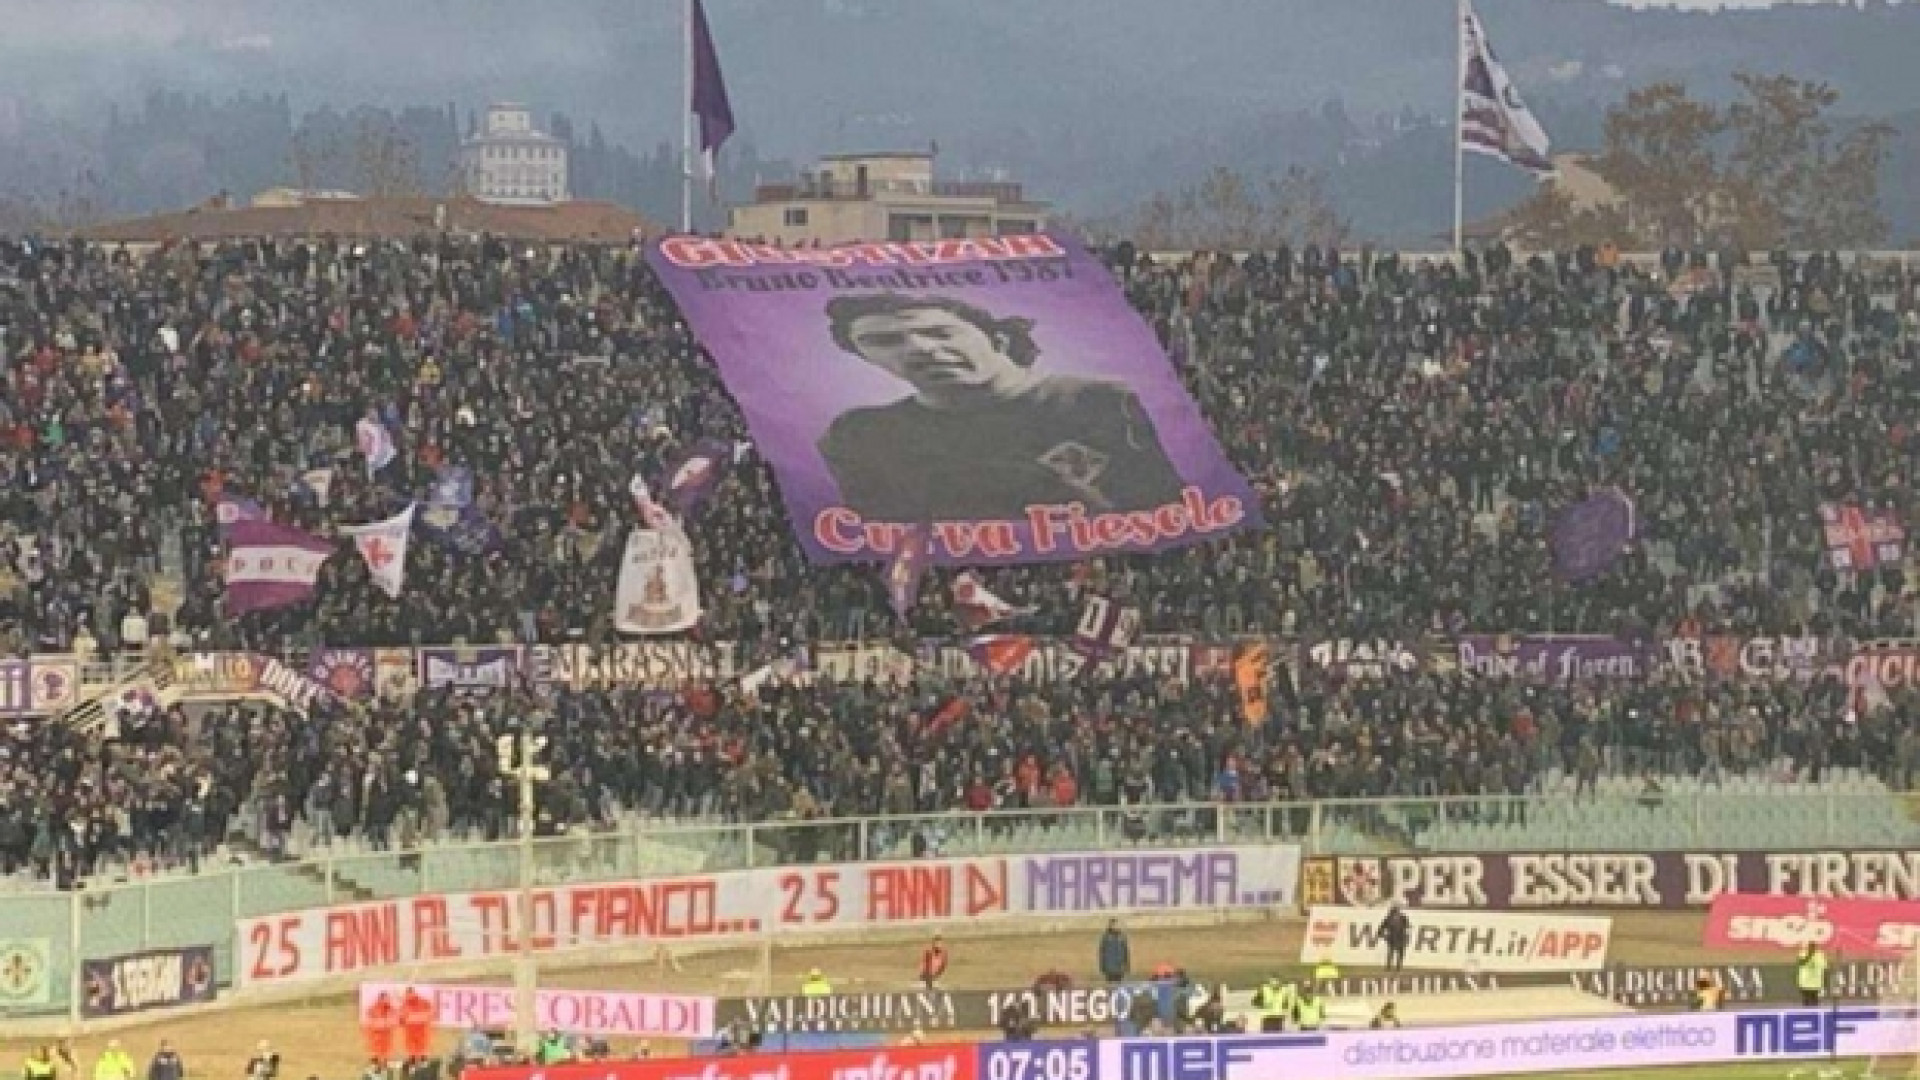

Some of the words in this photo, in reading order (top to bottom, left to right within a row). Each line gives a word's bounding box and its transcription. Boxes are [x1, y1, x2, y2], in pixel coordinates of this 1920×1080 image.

[813, 506, 1019, 557] Cuva
[1024, 486, 1243, 553] Fiesole
[1387, 854, 1488, 906] PER
[1507, 853, 1661, 905] ESSER
[1683, 853, 1738, 901] DI
[250, 921, 301, 980] 25
[325, 903, 399, 973] ANNI
[413, 893, 461, 961] AL
[780, 870, 840, 923] 25
[866, 868, 953, 921] ANNI
[964, 860, 1009, 916] DI
[1349, 921, 1604, 962] WRTH.it/APP
[433, 989, 703, 1033] FRESOBALDI
[989, 1049, 1089, 1080] 07:05
[1344, 1038, 1496, 1066] distribuzione
[1501, 1028, 1616, 1058] materiale
[1622, 1022, 1716, 1050] elettrico
